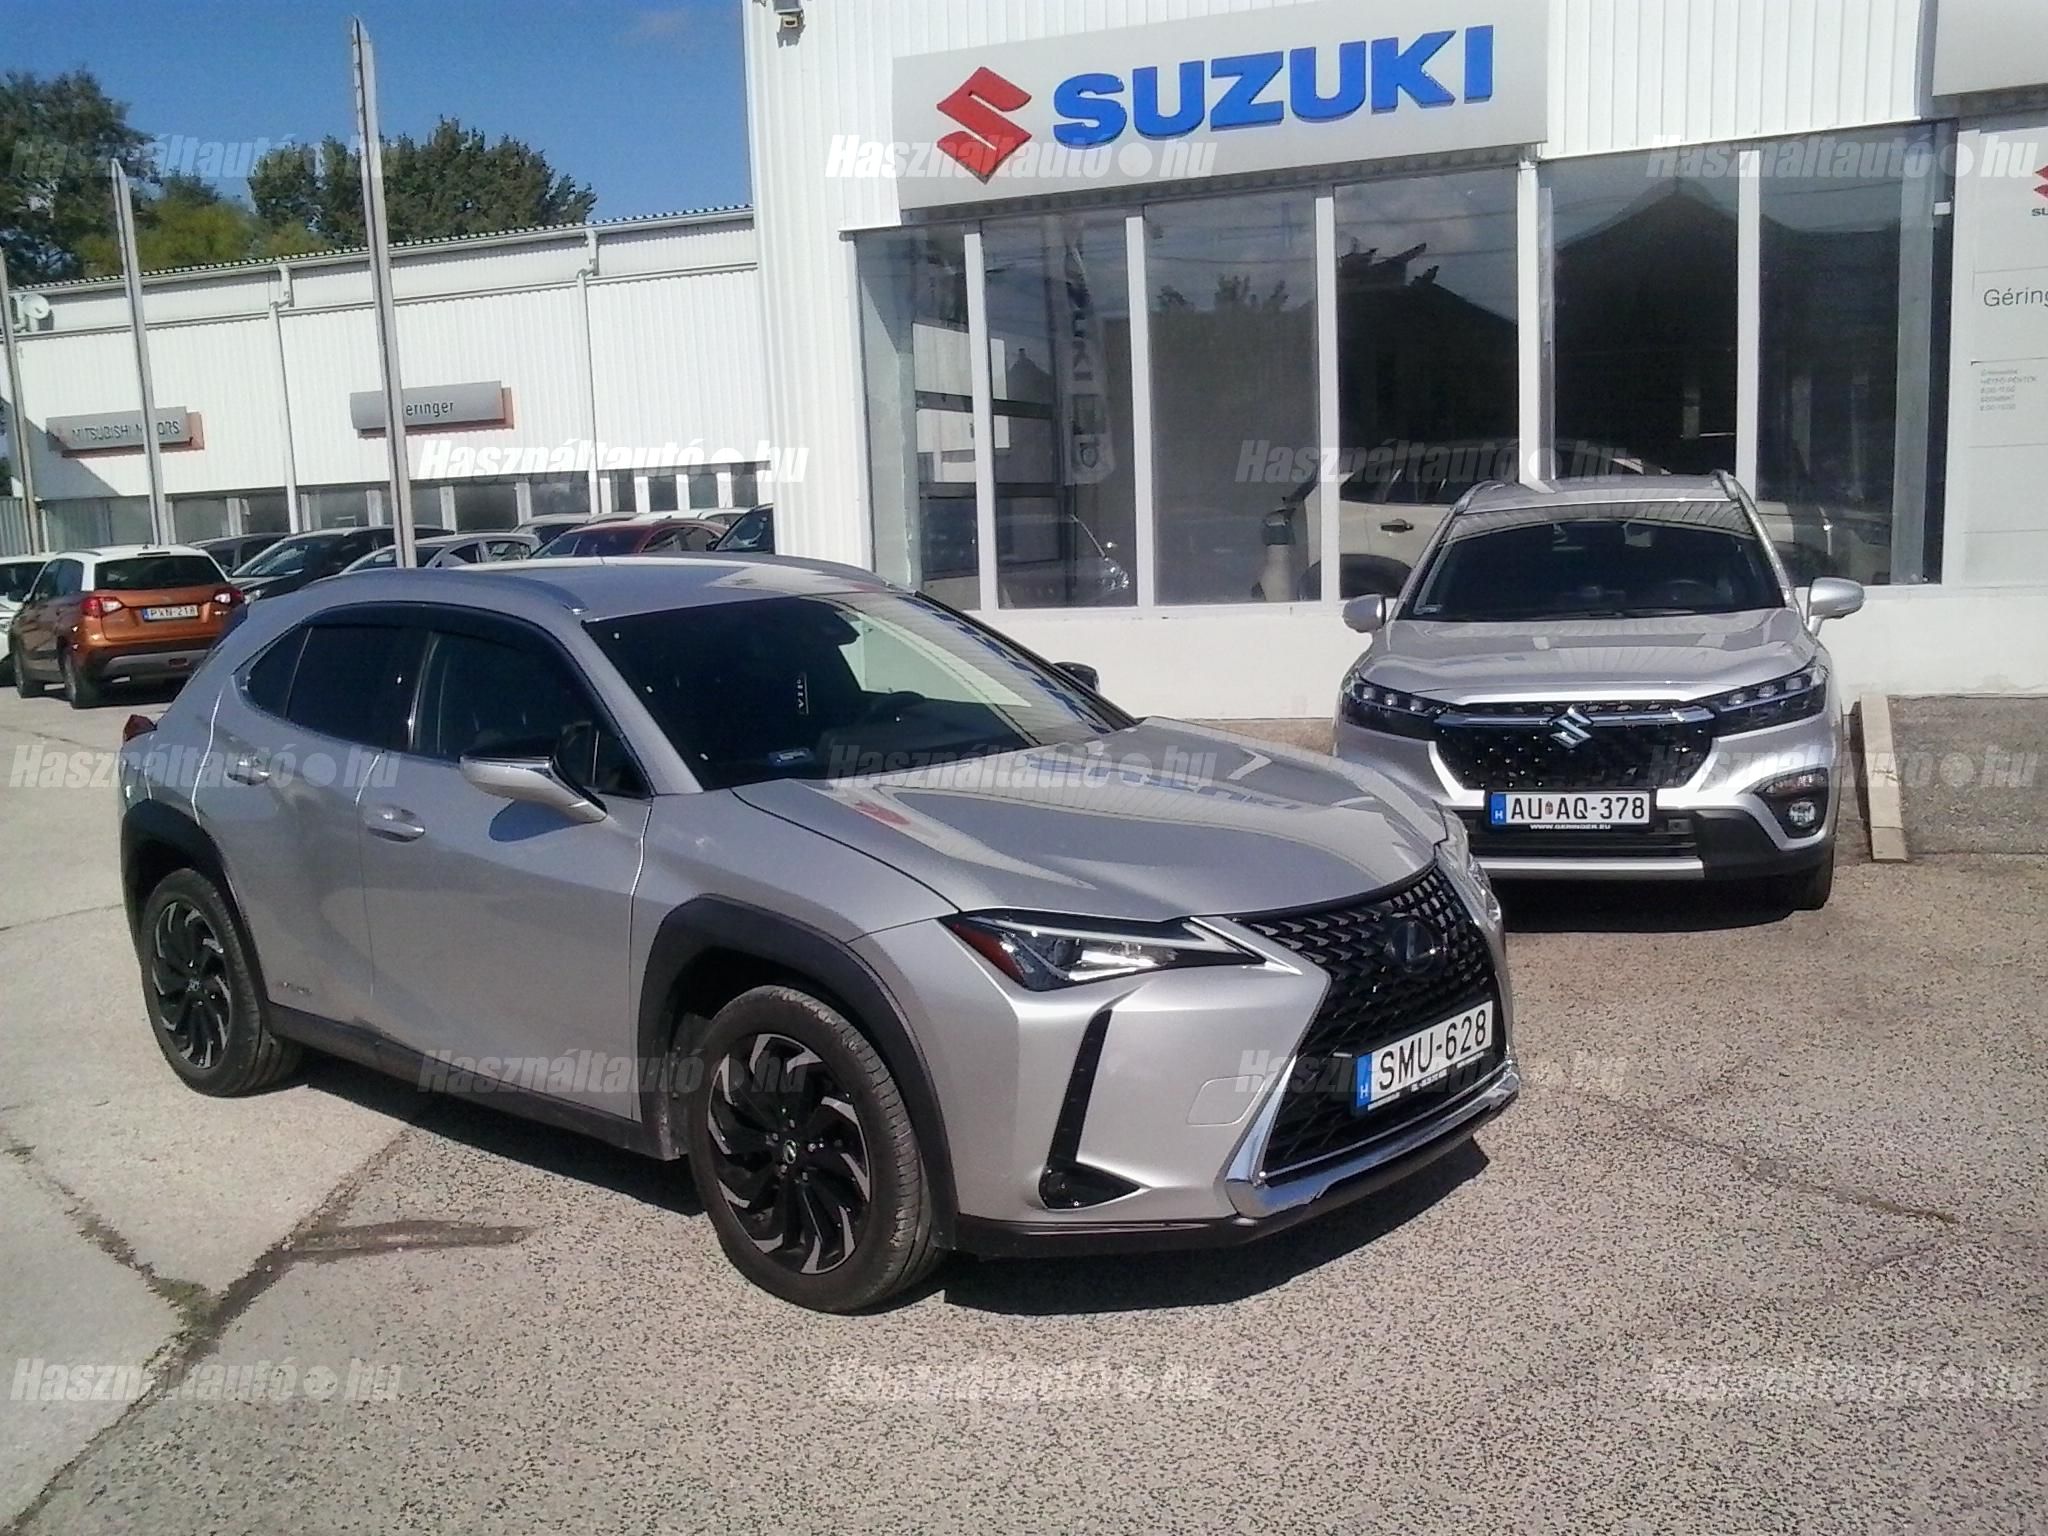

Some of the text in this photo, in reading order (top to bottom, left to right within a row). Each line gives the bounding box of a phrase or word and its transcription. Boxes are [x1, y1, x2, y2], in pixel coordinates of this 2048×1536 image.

[1053, 25, 1494, 150] SUZUKI
[405, 401, 455, 418] eringer
[1556, 797, 1645, 820] AQ-378
[1379, 1008, 1487, 1091] SMU-628
